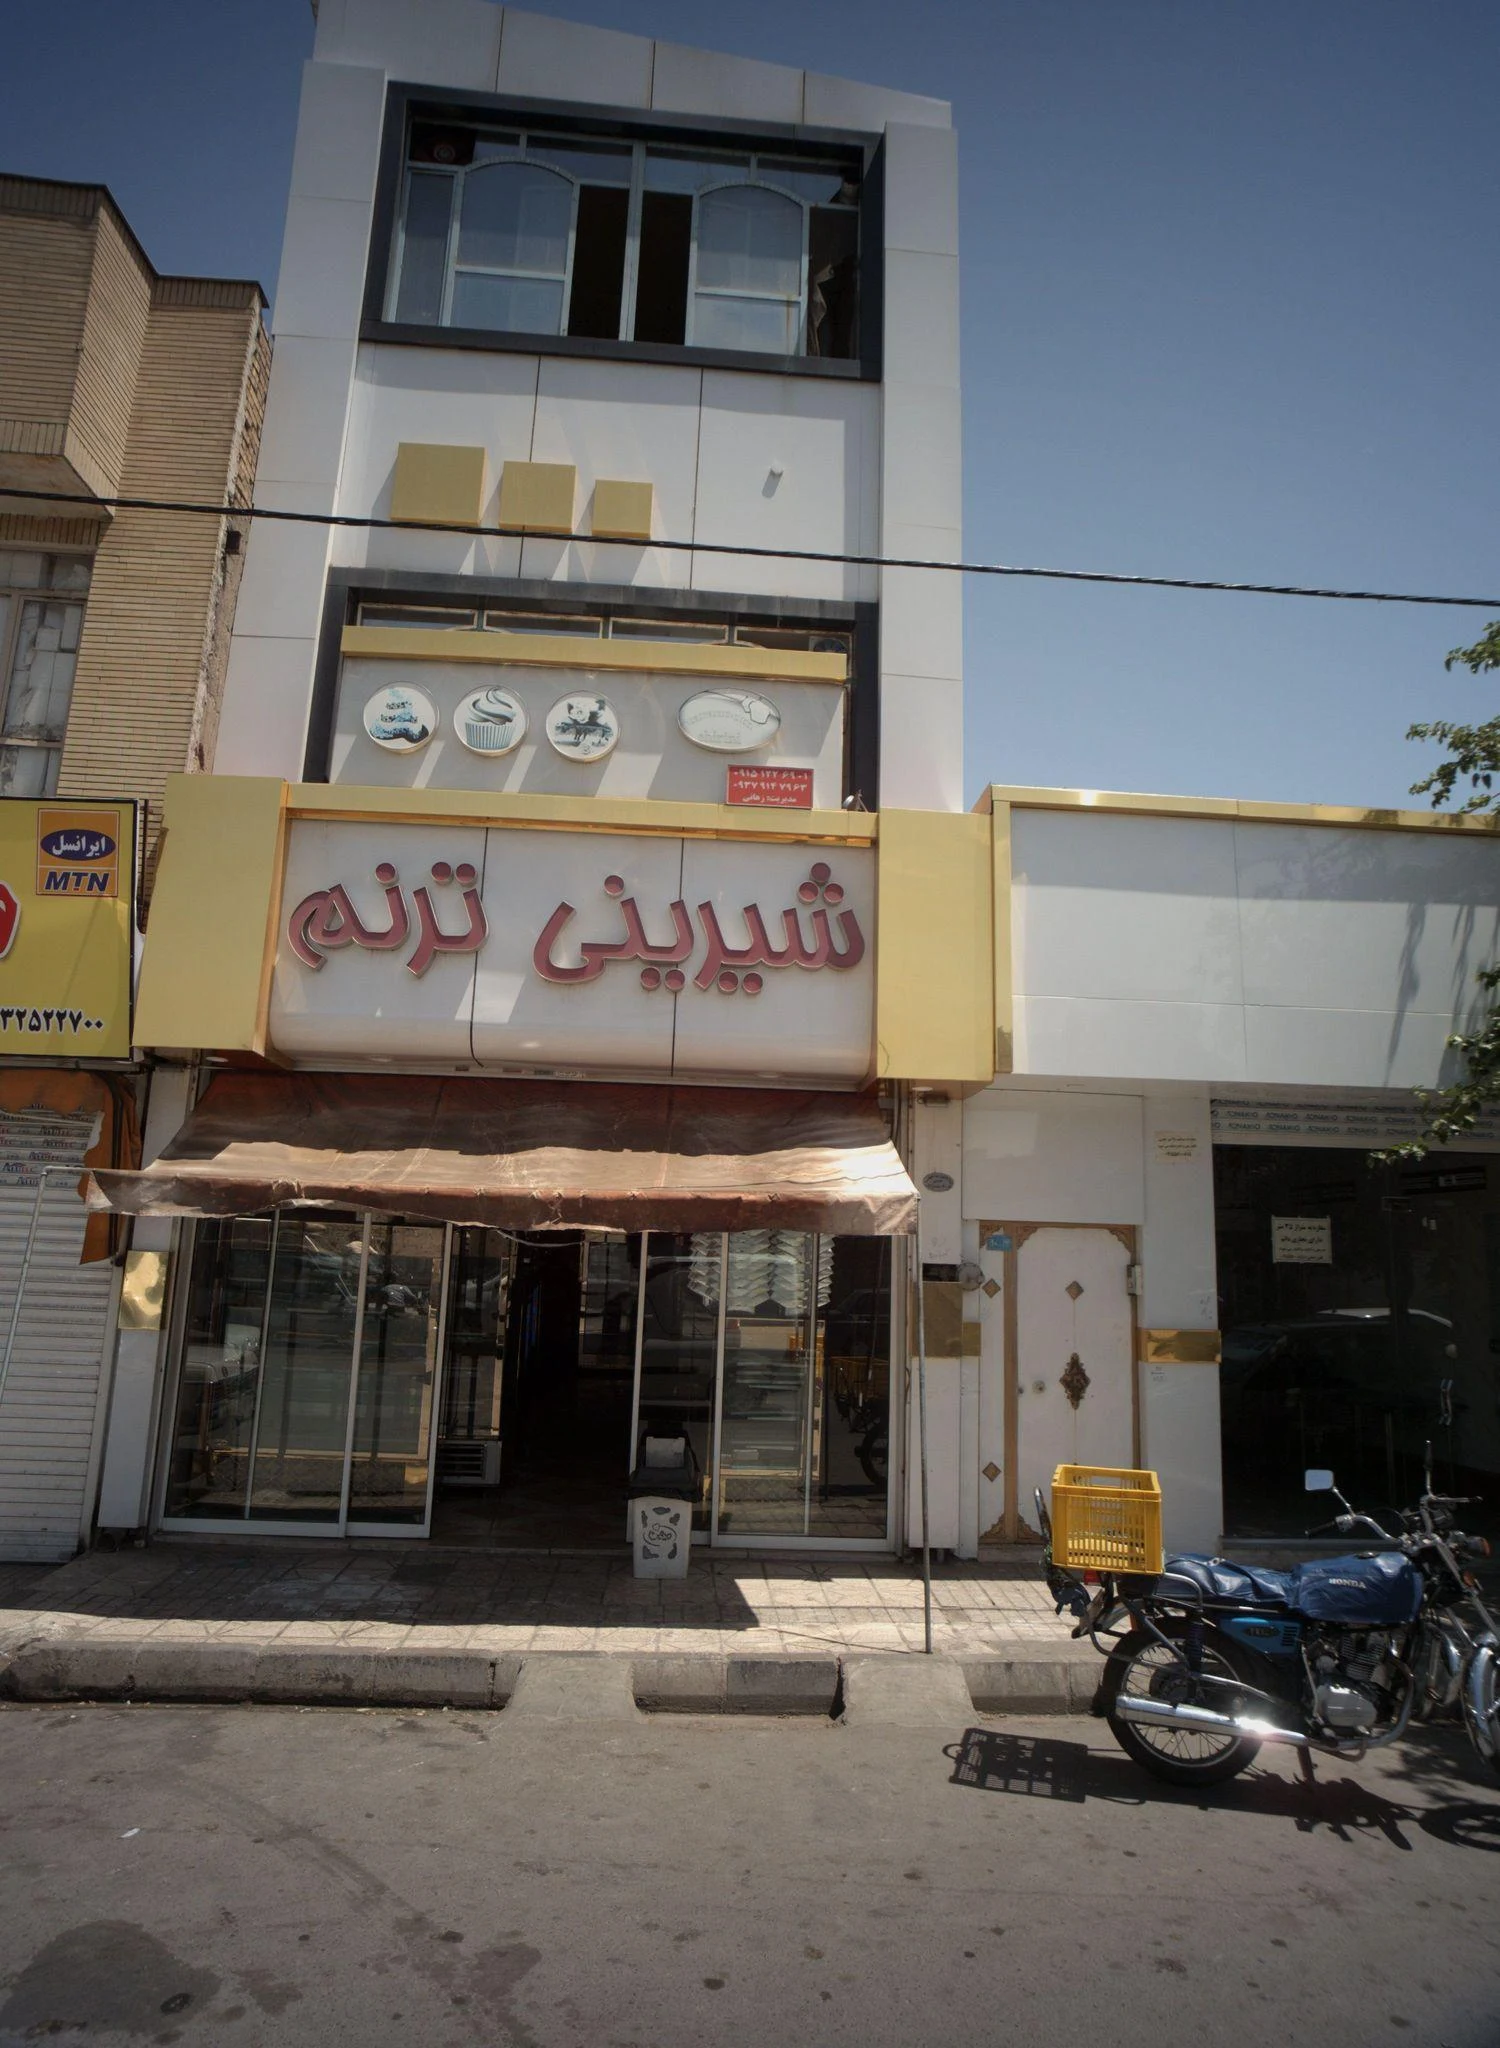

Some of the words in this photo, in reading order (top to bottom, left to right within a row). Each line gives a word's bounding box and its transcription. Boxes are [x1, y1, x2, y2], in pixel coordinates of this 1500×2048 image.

[52, 834, 106, 858] ایرانسل
[44, 871, 110, 891] MTN
[286, 861, 490, 978] ترنم
[533, 862, 866, 994] شیرینی
[1328, 1578, 1367, 1589] HONDA
